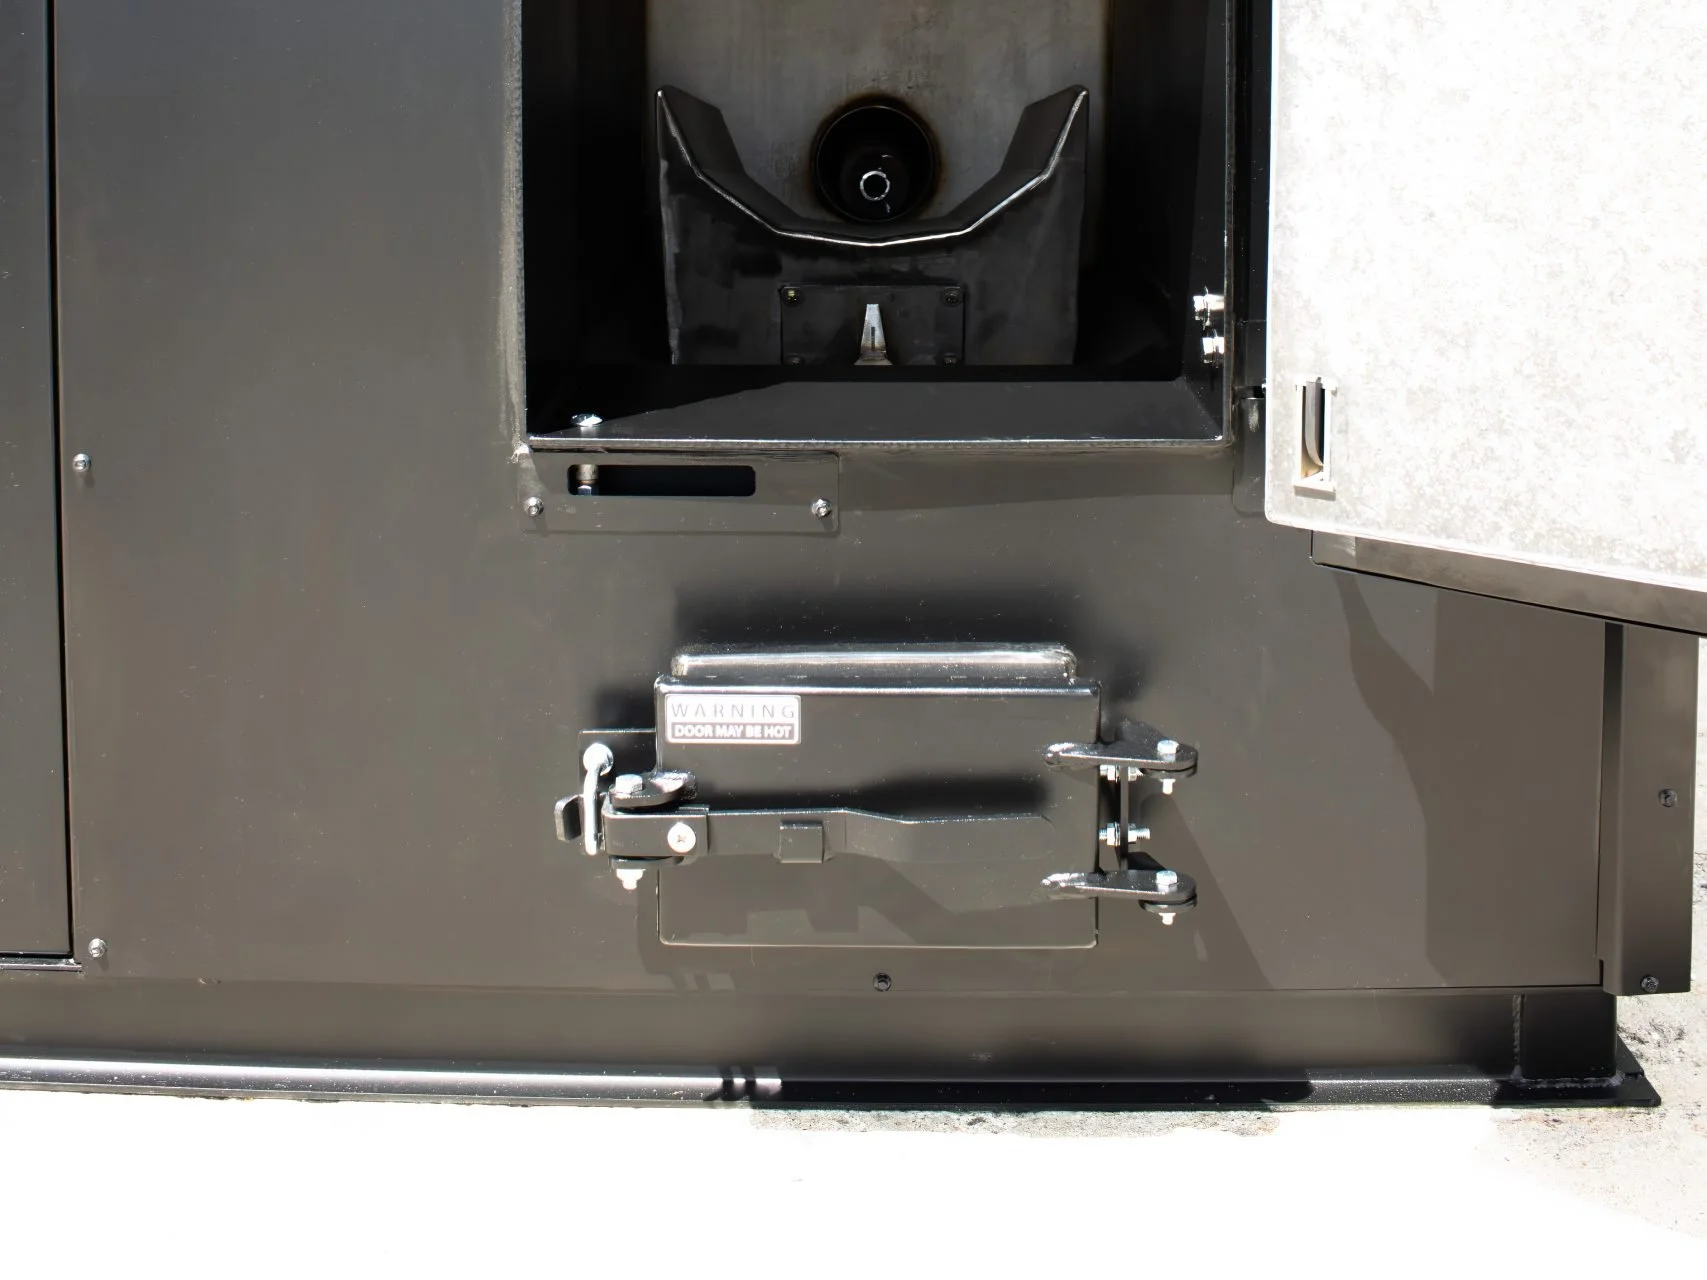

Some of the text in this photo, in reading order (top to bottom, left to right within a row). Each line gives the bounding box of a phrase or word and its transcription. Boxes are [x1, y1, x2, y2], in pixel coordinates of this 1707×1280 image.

[671, 702, 795, 719] WARNING
[674, 724, 792, 738] DOOR MAY BE HOT
